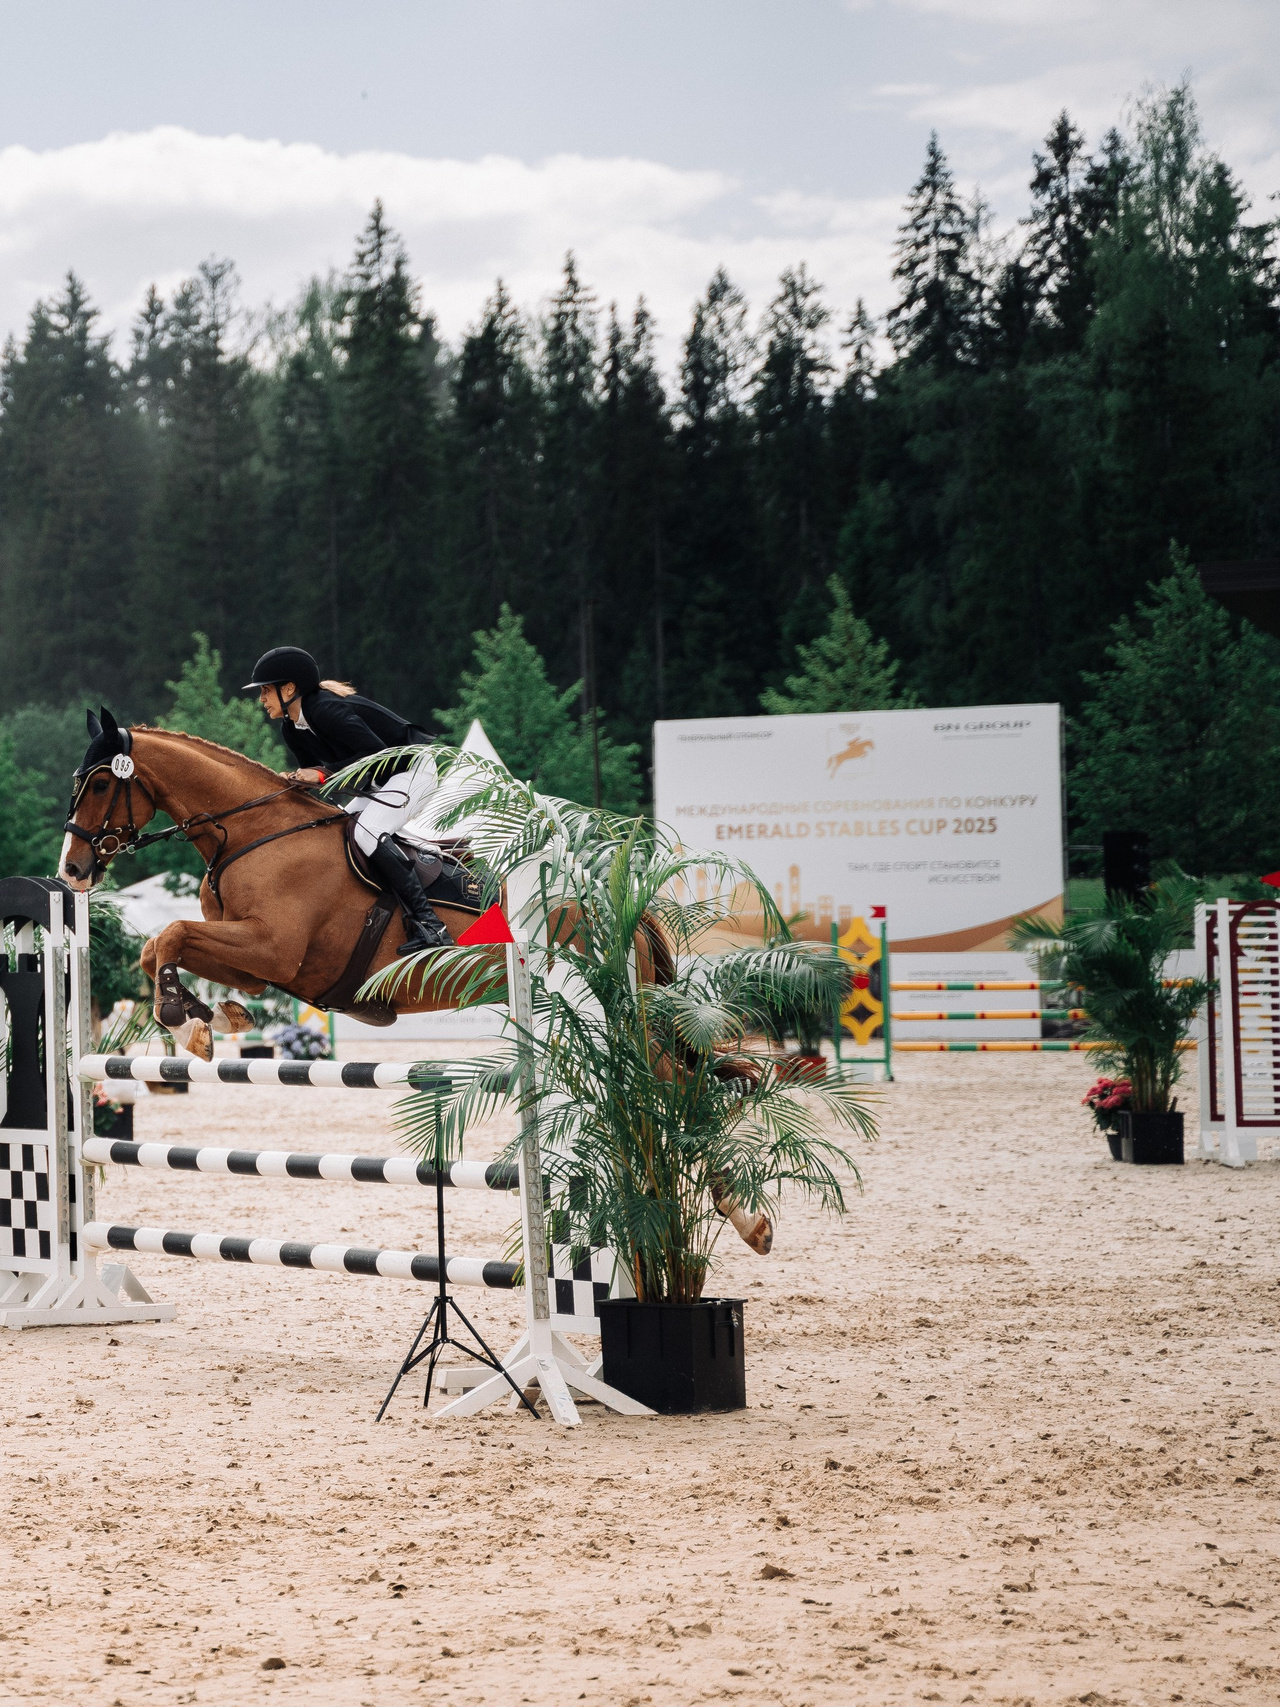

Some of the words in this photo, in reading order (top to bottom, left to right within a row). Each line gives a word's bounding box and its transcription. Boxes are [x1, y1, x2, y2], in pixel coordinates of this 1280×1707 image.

[115, 759, 131, 772] 095
[675, 800, 809, 818] МЕЖДУНАРОДНЫЕ
[938, 796, 961, 809] ПО
[964, 793, 1038, 810] КОНКУРУ
[715, 820, 811, 840] EMERALD
[814, 819, 900, 838] STABLES
[904, 817, 948, 836] CUP
[952, 816, 999, 835] 2025
[893, 860, 928, 872] СПОРТ
[929, 859, 1001, 871] СТАНОВИТСЯ
[928, 873, 1001, 885] ИСКУССТВОМ
